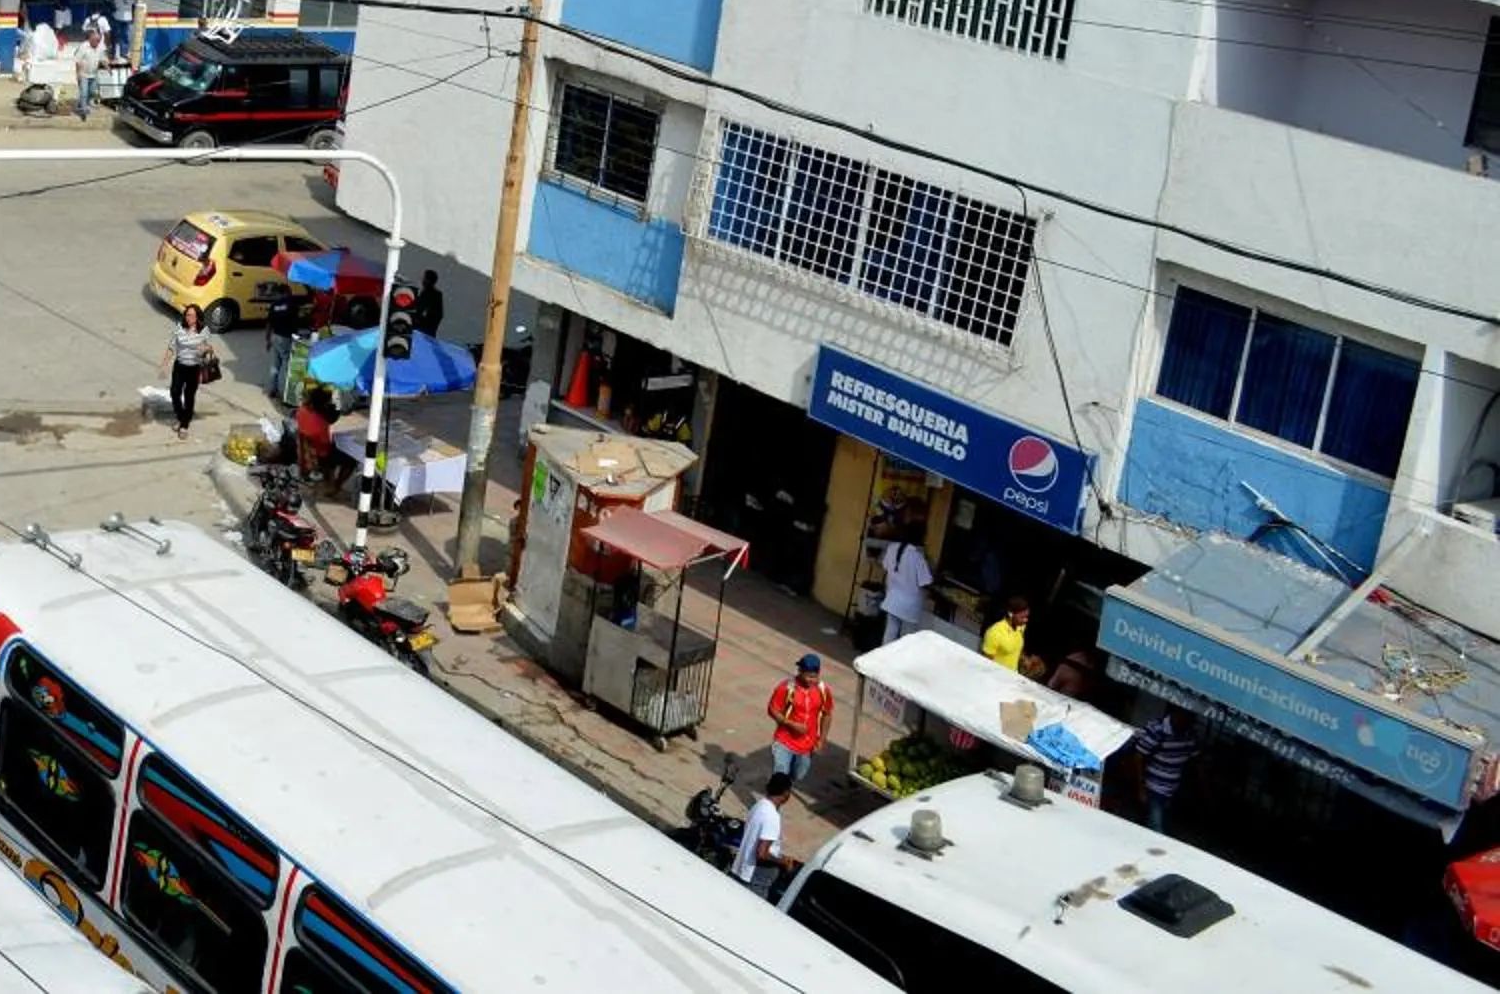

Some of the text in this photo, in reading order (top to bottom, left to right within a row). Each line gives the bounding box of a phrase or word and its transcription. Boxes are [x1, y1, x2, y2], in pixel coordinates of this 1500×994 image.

[827, 390, 884, 426] MISTER
[831, 370, 969, 444] REFRESQUERIA
[1002, 486, 1049, 516] pepsi
[1113, 618, 1183, 662] Deivitel
[1184, 650, 1340, 731] Comunicaciones
